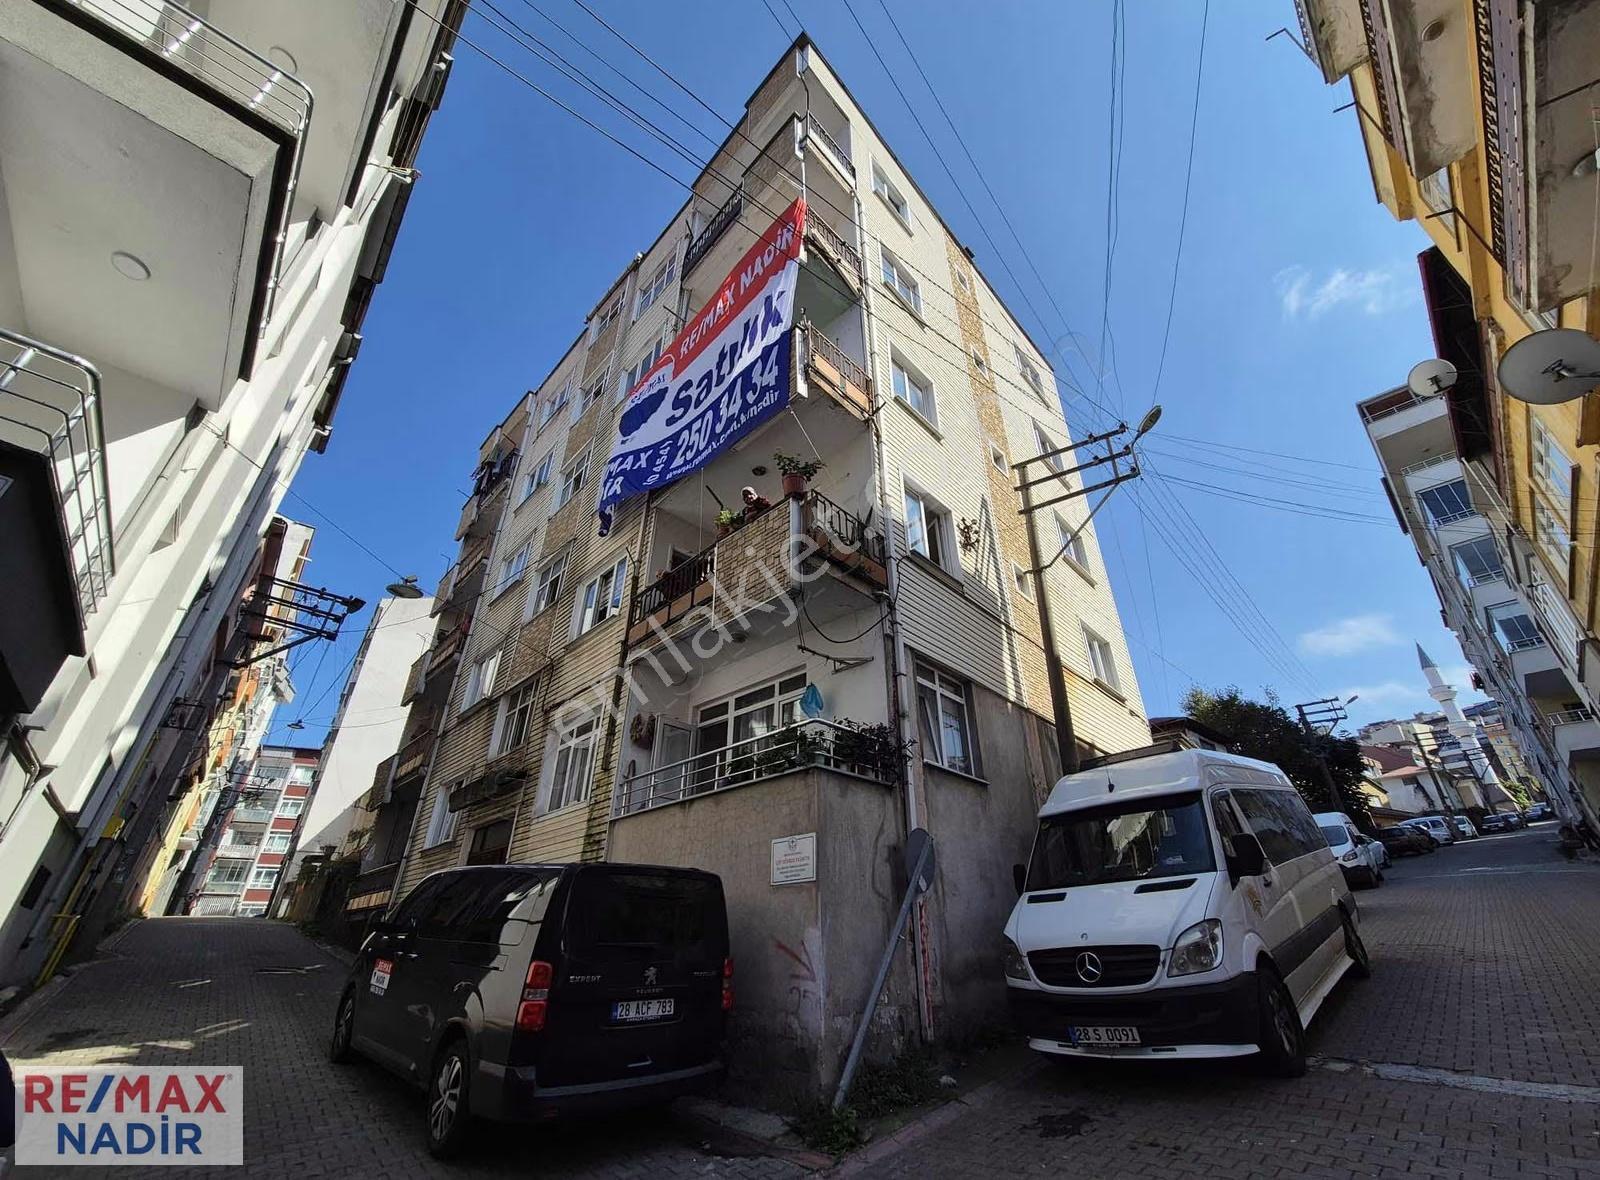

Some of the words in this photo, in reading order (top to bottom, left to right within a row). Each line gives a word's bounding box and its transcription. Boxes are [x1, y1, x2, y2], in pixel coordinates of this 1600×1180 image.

[680, 281, 736, 359] RE/MAX
[740, 222, 797, 297] NADİR
[669, 409, 714, 470] 250
[715, 376, 743, 433] 34
[746, 345, 778, 404] 34
[619, 1003, 631, 1017] 28
[635, 1001, 652, 1016] ACF
[656, 999, 673, 1014] 783
[1075, 1028, 1091, 1041] 28
[1093, 1028, 1102, 1041] S
[1106, 1028, 1138, 1042] 0091
